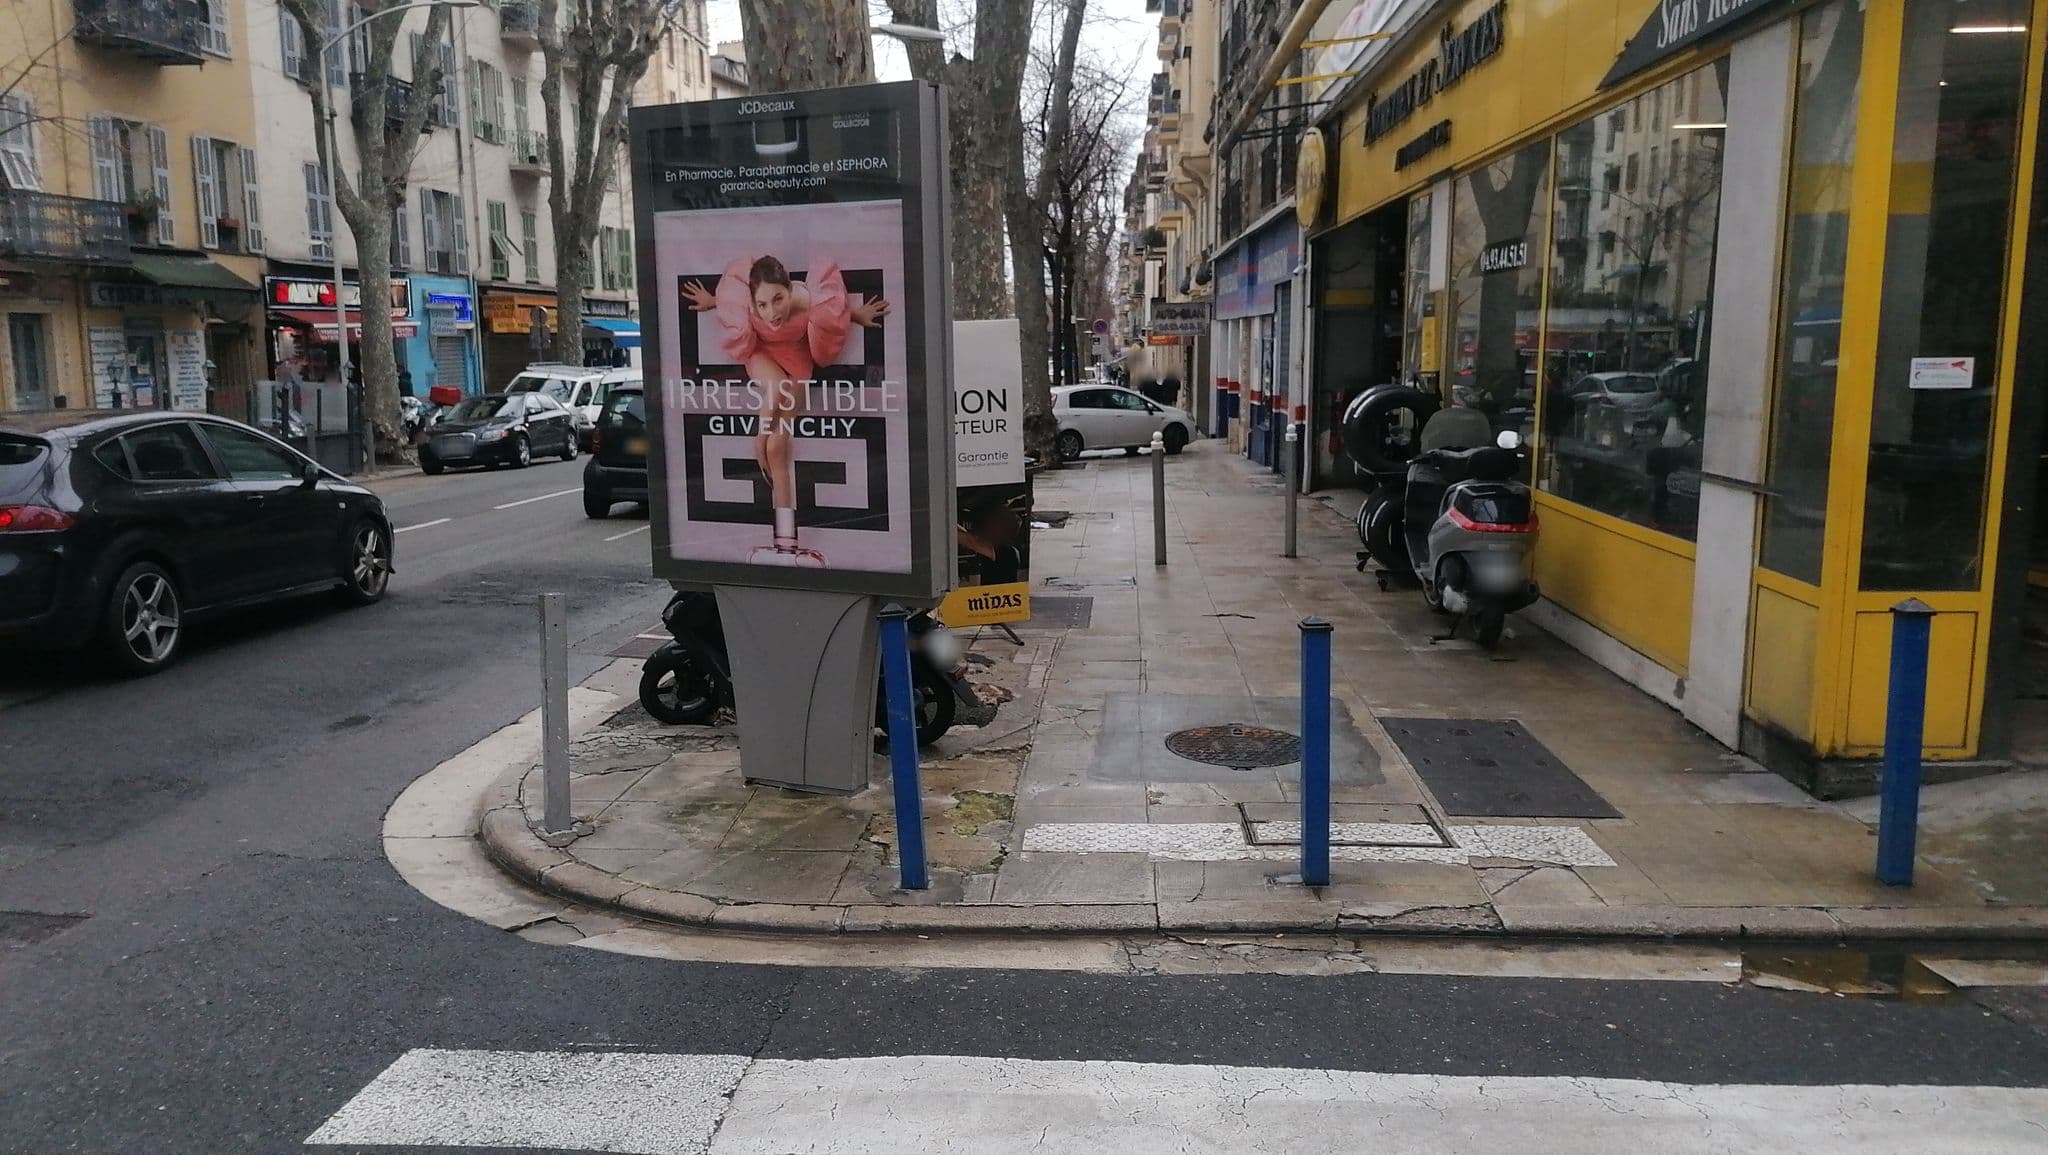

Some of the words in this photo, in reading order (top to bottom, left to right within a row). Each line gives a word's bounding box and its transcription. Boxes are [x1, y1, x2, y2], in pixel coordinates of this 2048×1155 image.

[1656, 0, 1699, 48] Sans
[738, 100, 795, 115] JCDecaux
[665, 171, 677, 182] En
[679, 167, 736, 181] Pharmacie,
[739, 161, 820, 177] Parapharmacie
[822, 162, 834, 172] et
[836, 157, 888, 171] SEPHORA
[720, 176, 827, 193] garancia-beauty.com
[668, 379, 901, 412] IRRESISTIBLE
[709, 416, 857, 438] GIVENCHY
[957, 450, 1009, 463] Garantie
